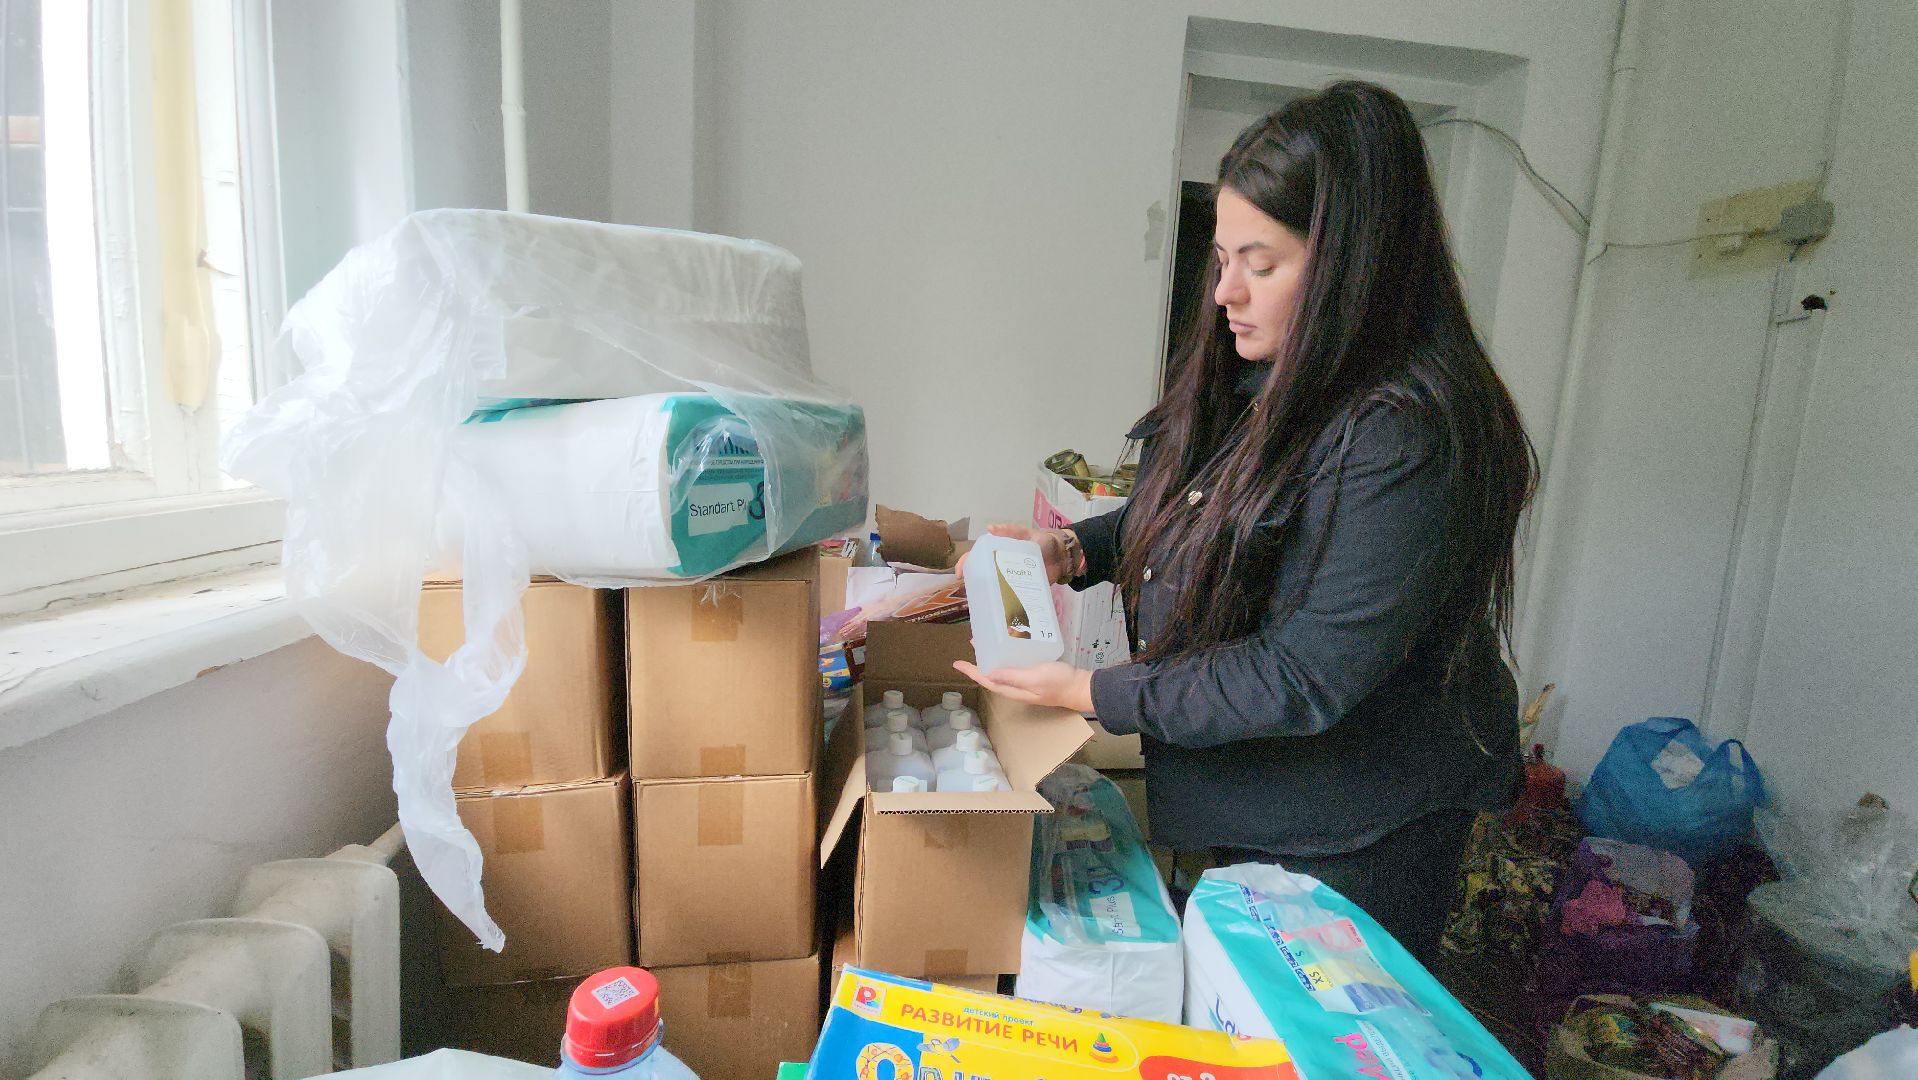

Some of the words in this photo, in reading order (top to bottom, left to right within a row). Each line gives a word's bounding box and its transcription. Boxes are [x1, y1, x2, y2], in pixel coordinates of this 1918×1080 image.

[689, 501, 735, 518] Standart
[963, 1007, 1000, 1020] детский
[1002, 1014, 1034, 1027] проект
[900, 1003, 1013, 1040] РАЗВИТИЕ
[1022, 1028, 1078, 1053] РЕЧИ
